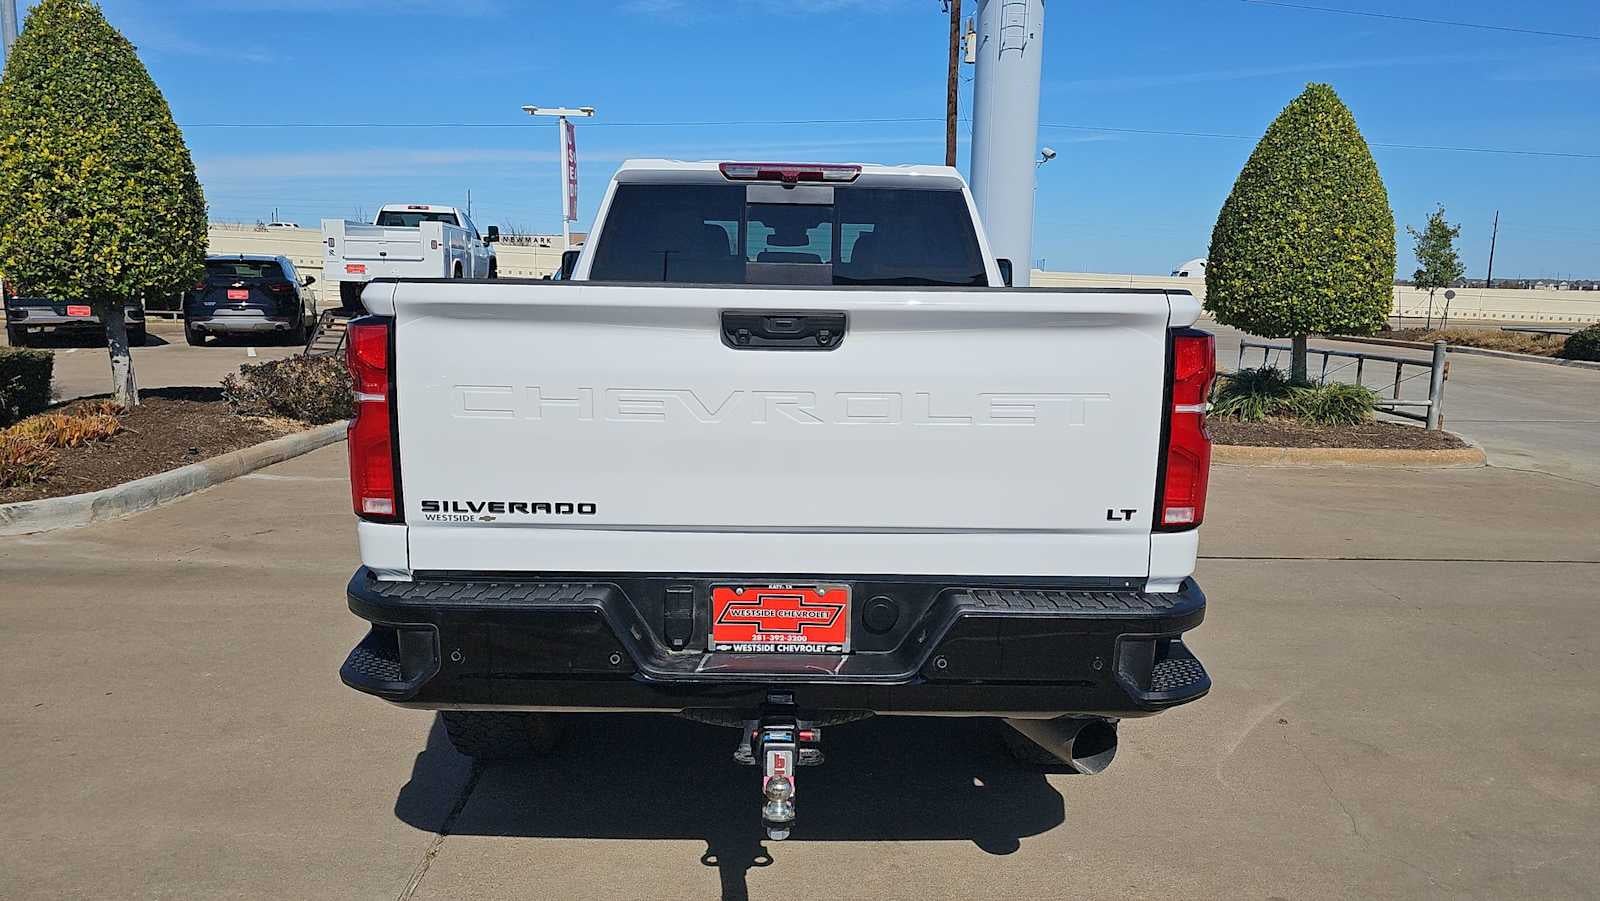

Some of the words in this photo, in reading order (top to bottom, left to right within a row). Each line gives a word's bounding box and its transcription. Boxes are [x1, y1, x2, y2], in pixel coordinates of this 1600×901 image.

[503, 236, 551, 244] NEWMARK
[451, 384, 1112, 427] CHEVROLET
[421, 500, 597, 514] SILVERADO
[425, 514, 475, 522] WESTSIDE
[1106, 509, 1137, 521] LT
[730, 609, 775, 617] WESTSIDE
[776, 610, 830, 619] CHEVROLET
[752, 634, 808, 642] 281-392-3200
[733, 644, 775, 652] WESTSIDE
[776, 644, 826, 653] CHEVROLET
